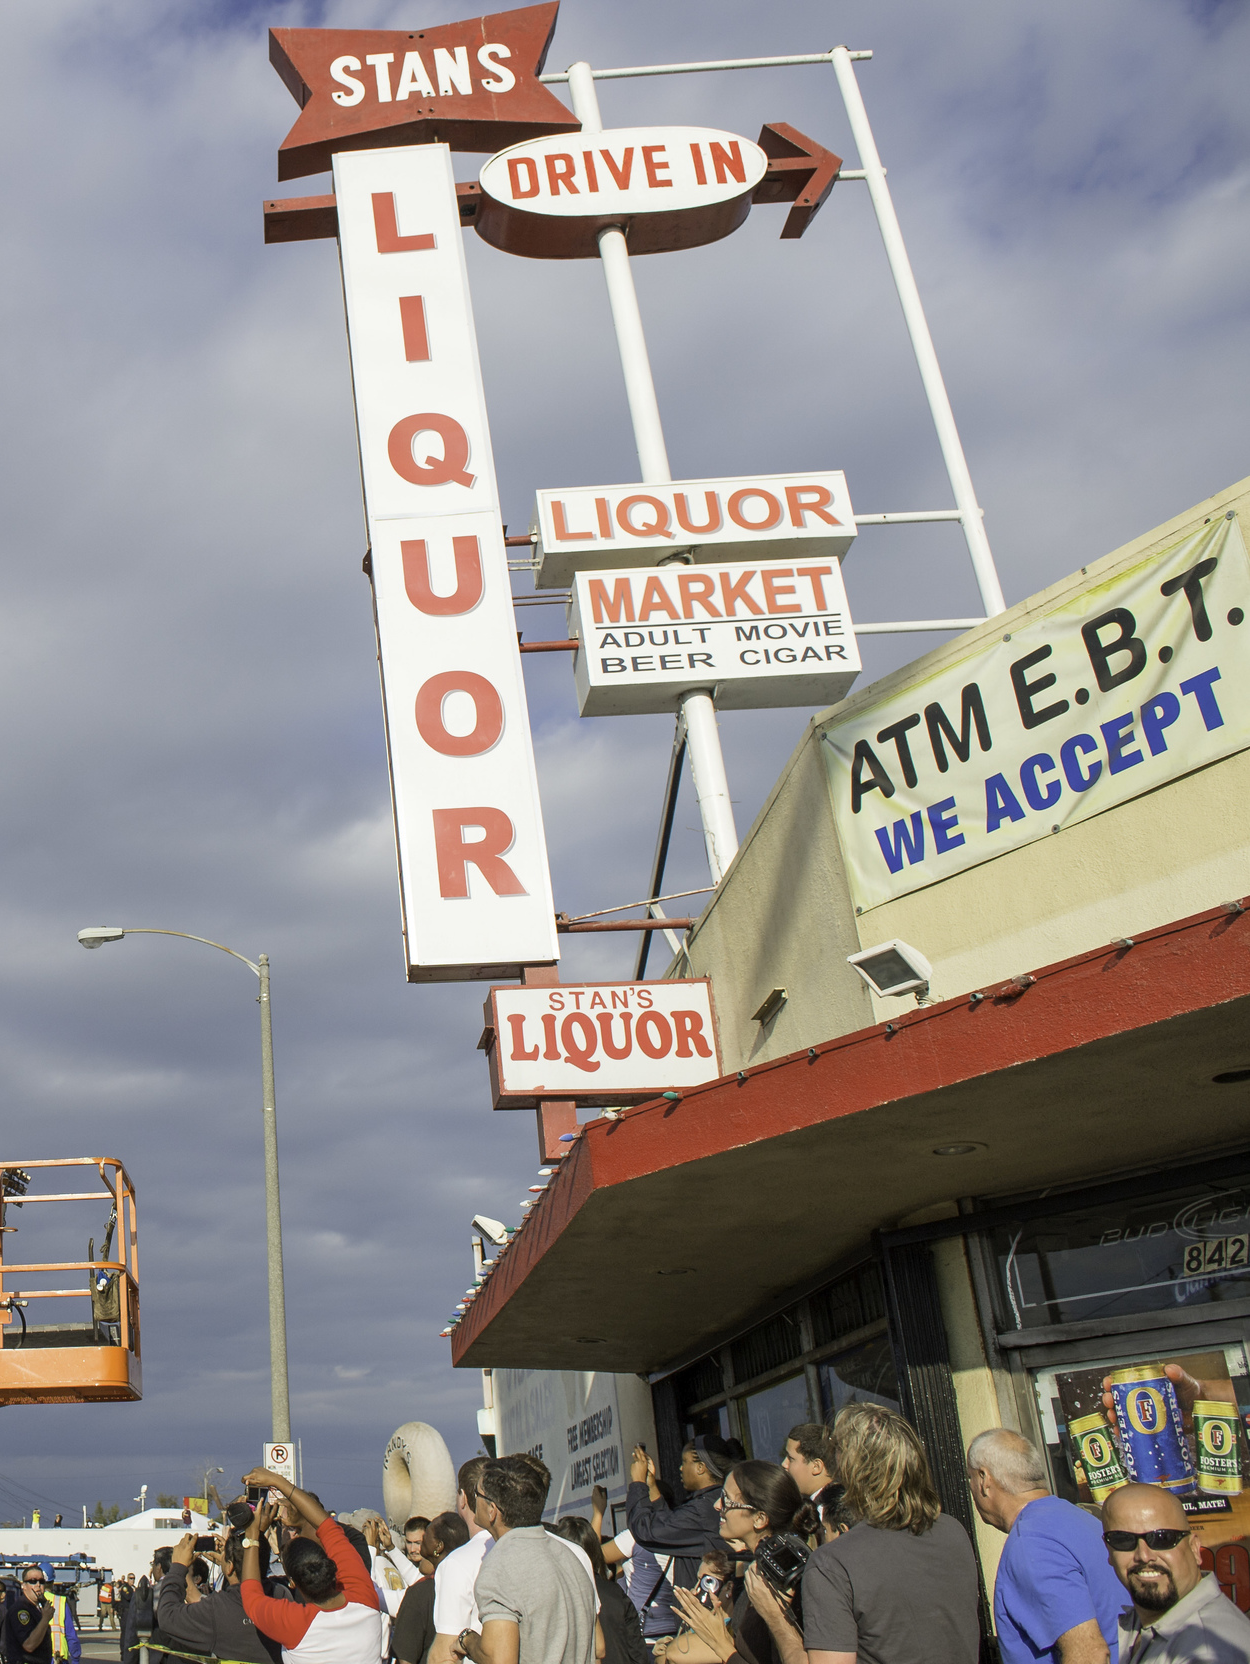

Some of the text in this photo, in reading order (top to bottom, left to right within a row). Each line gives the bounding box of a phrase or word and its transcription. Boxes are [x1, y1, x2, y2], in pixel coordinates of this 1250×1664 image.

[506, 140, 747, 200] DRIVE IN
[550, 484, 843, 541] LIQUOR
[370, 191, 531, 901] LIQUOR
[587, 566, 833, 625] MARKET
[599, 620, 845, 649] ADULT MOVIE
[600, 644, 849, 674] BEER CIGAR
[851, 557, 1244, 814] ATM E.B.T.
[874, 666, 1225, 875] WE ACCEPT
[549, 987, 654, 1012] STAN'S
[507, 1010, 713, 1073] LIQUOR
[1100, 1222, 1168, 1247] BUD
[567, 1424, 578, 1454] FREE
[579, 1405, 612, 1450] MEMBERSHIP
[571, 1445, 619, 1491] LARGEST SELECTION
[1198, 1499, 1226, 1509] MATE!
